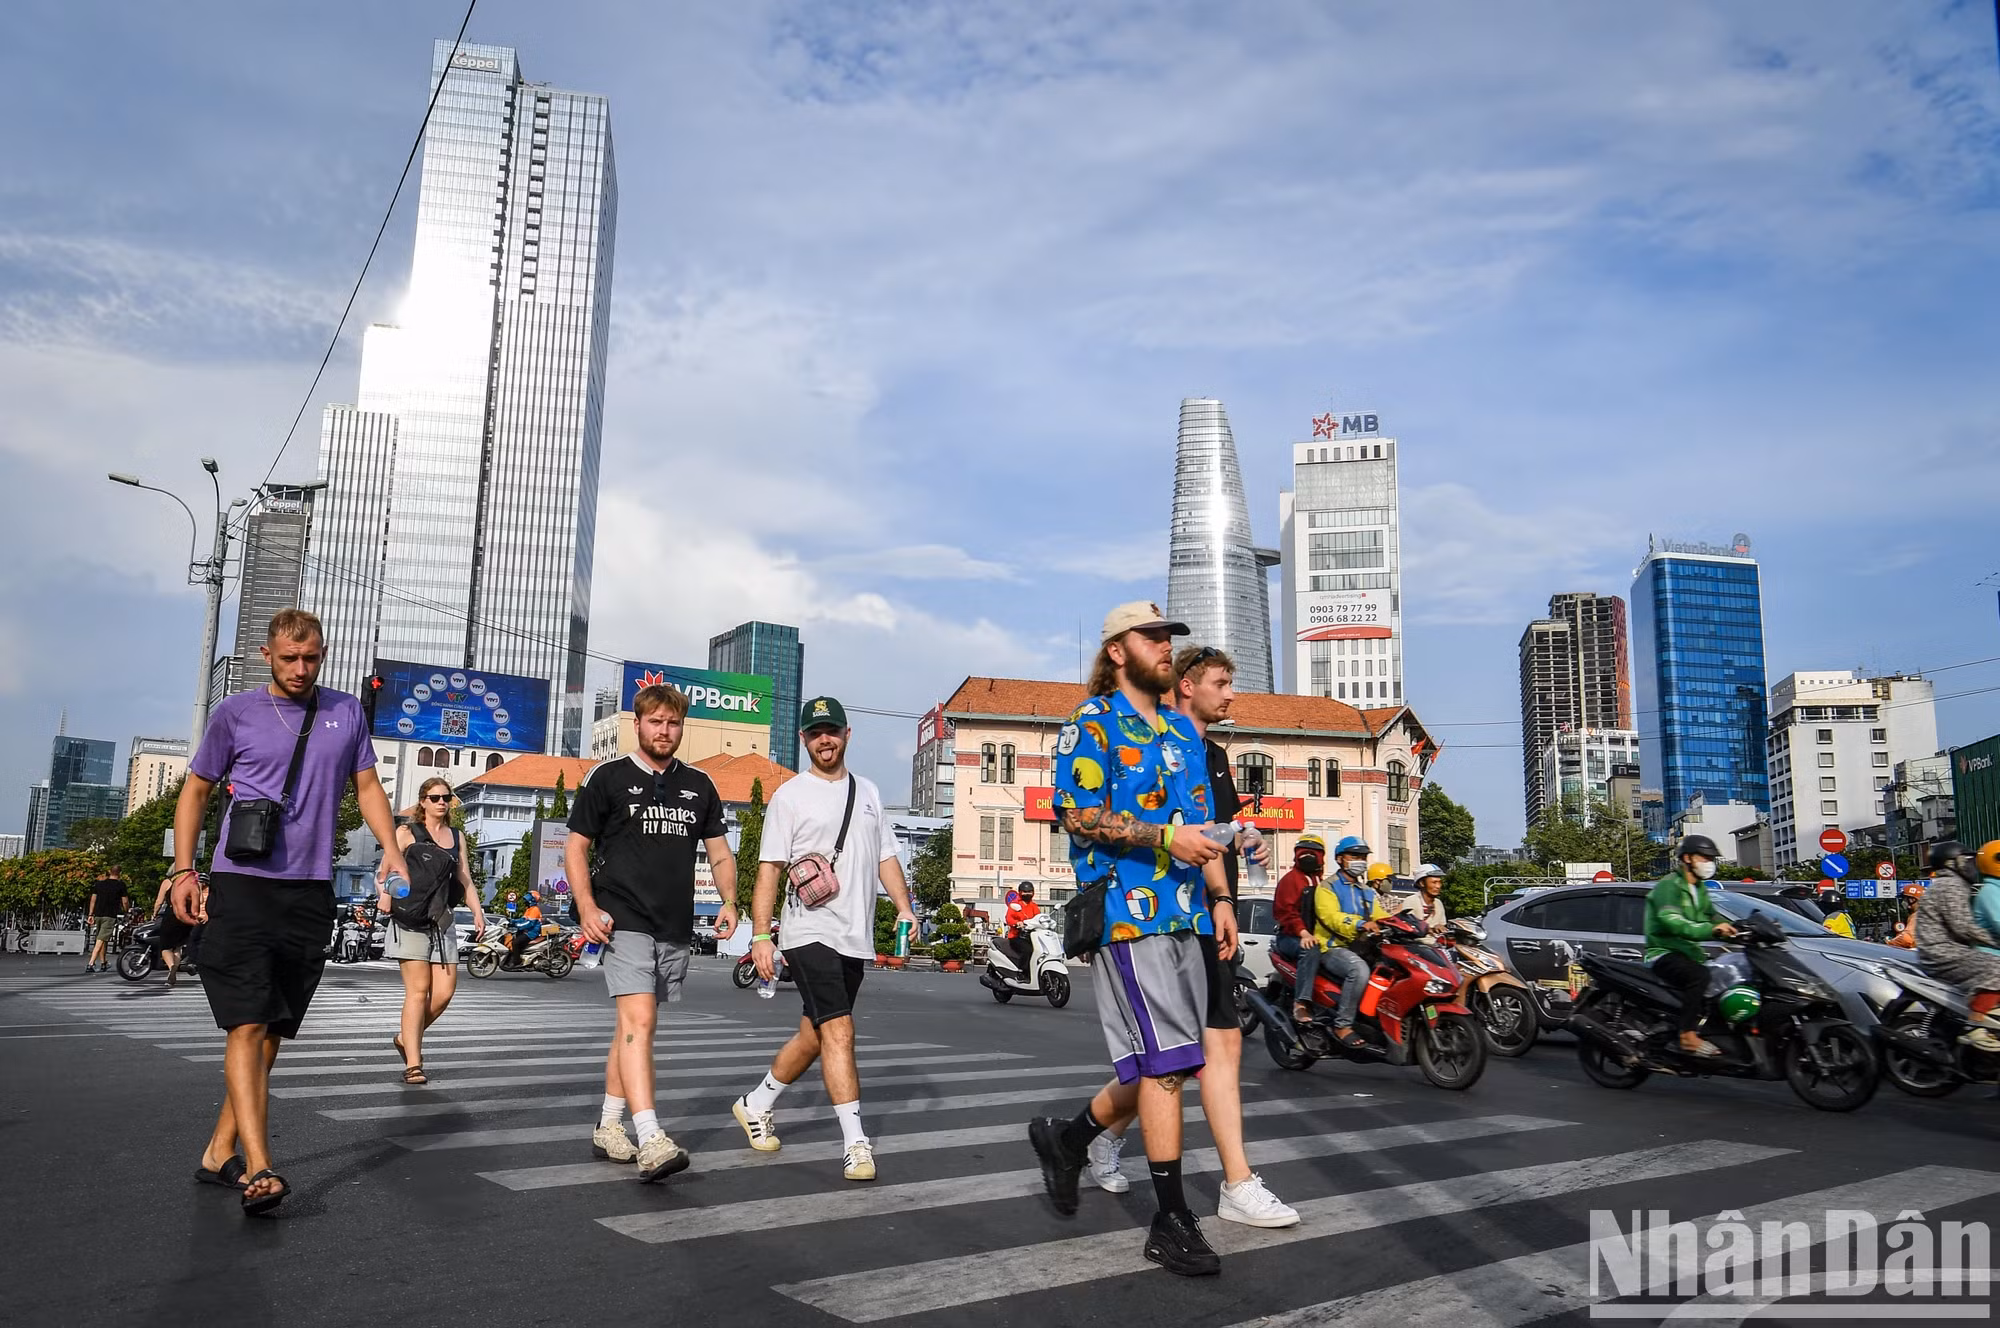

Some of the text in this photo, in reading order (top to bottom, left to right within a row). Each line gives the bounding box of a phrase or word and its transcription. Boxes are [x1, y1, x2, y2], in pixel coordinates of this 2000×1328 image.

[450, 55, 498, 69] Keppel
[1342, 414, 1379, 434] MB
[266, 499, 300, 508] Keppel
[1310, 603, 1377, 613] 0903 79 77 99
[1310, 615, 1334, 623] 0906
[1351, 614, 1362, 622] 22
[1968, 753, 1994, 772] VPBank
[1284, 808, 1294, 819] TA
[643, 820, 659, 834] FLY
